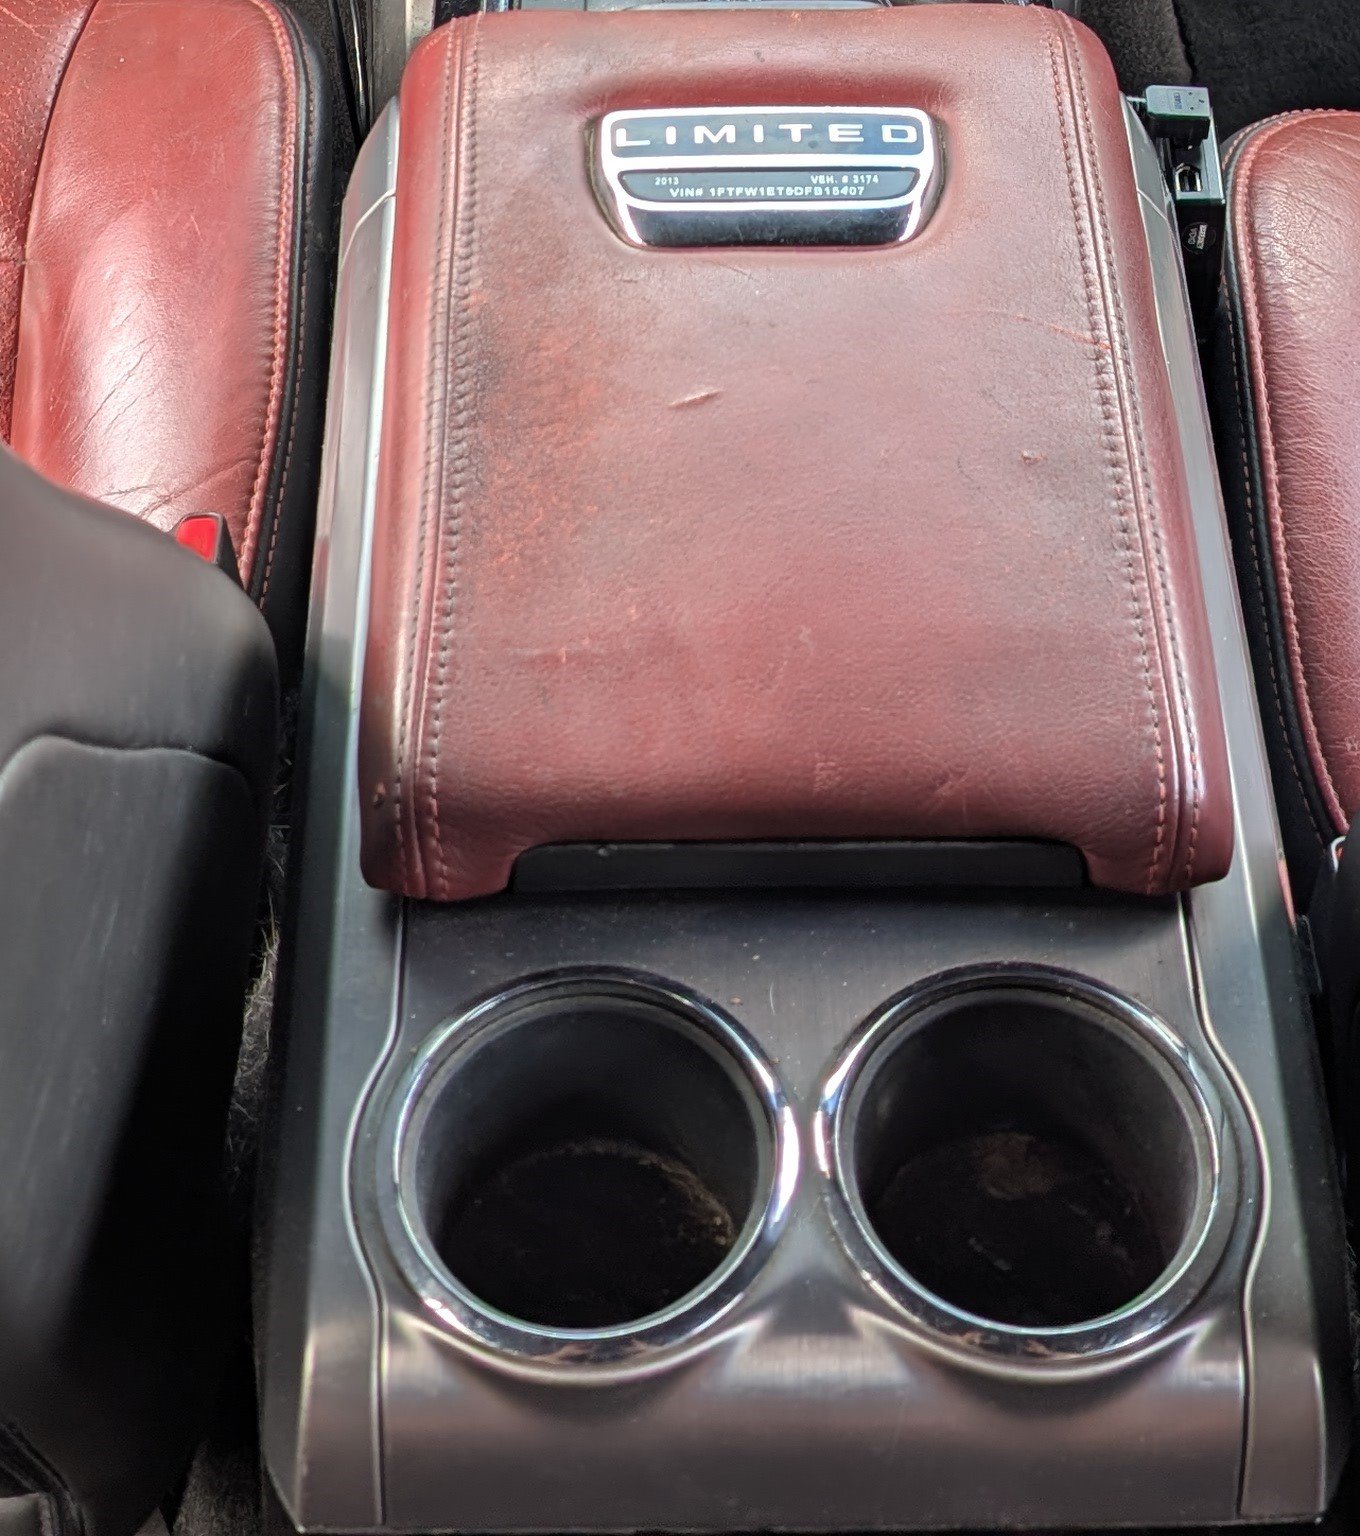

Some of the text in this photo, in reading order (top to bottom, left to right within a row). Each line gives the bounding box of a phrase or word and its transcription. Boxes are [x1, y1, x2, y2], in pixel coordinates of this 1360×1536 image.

[615, 123, 917, 148] LIMITED
[655, 177, 679, 186] 2013
[853, 174, 879, 184] 3174
[669, 188, 704, 198] VIN#
